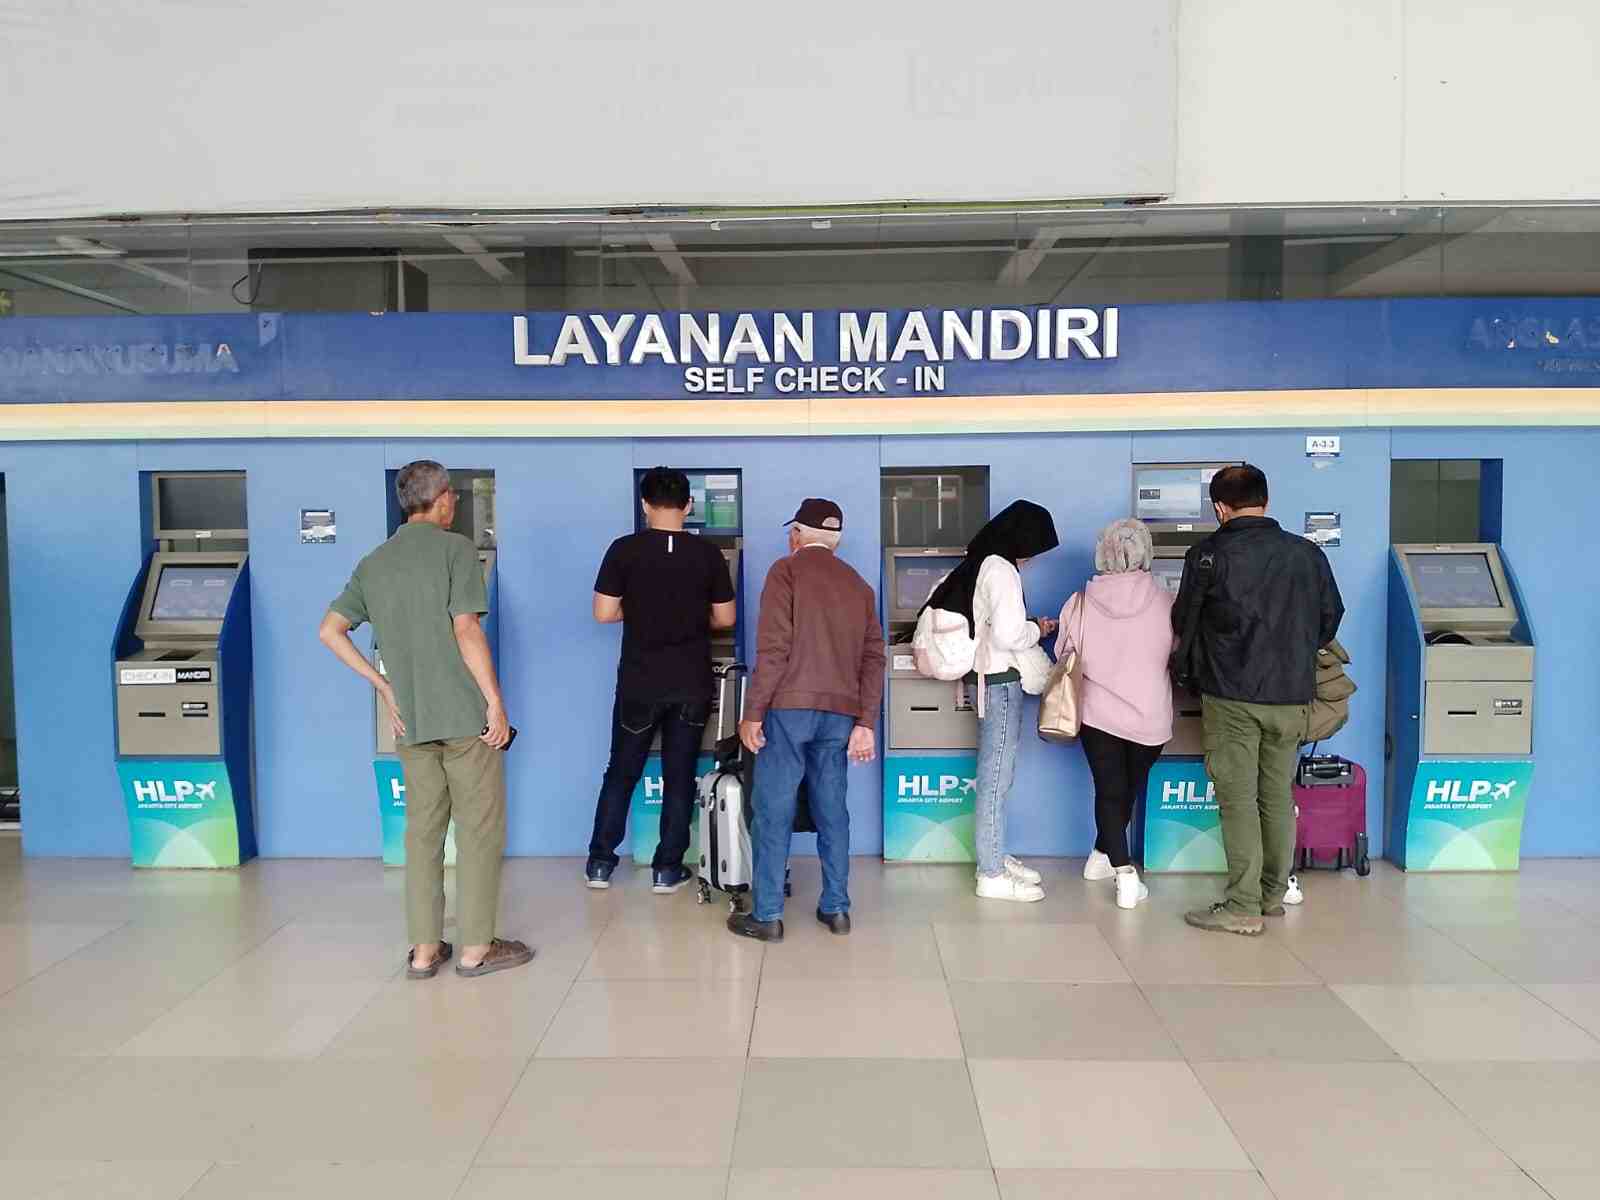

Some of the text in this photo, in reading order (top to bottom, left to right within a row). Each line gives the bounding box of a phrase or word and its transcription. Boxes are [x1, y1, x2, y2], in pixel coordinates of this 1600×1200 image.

[513, 307, 1119, 366] LAYANAN MANDIRI
[684, 365, 764, 394] SELF
[774, 365, 885, 393] CHECK
[915, 365, 945, 392] IN
[133, 780, 194, 802] HLP
[898, 775, 959, 796] HLP
[1426, 780, 1491, 802] HLP
